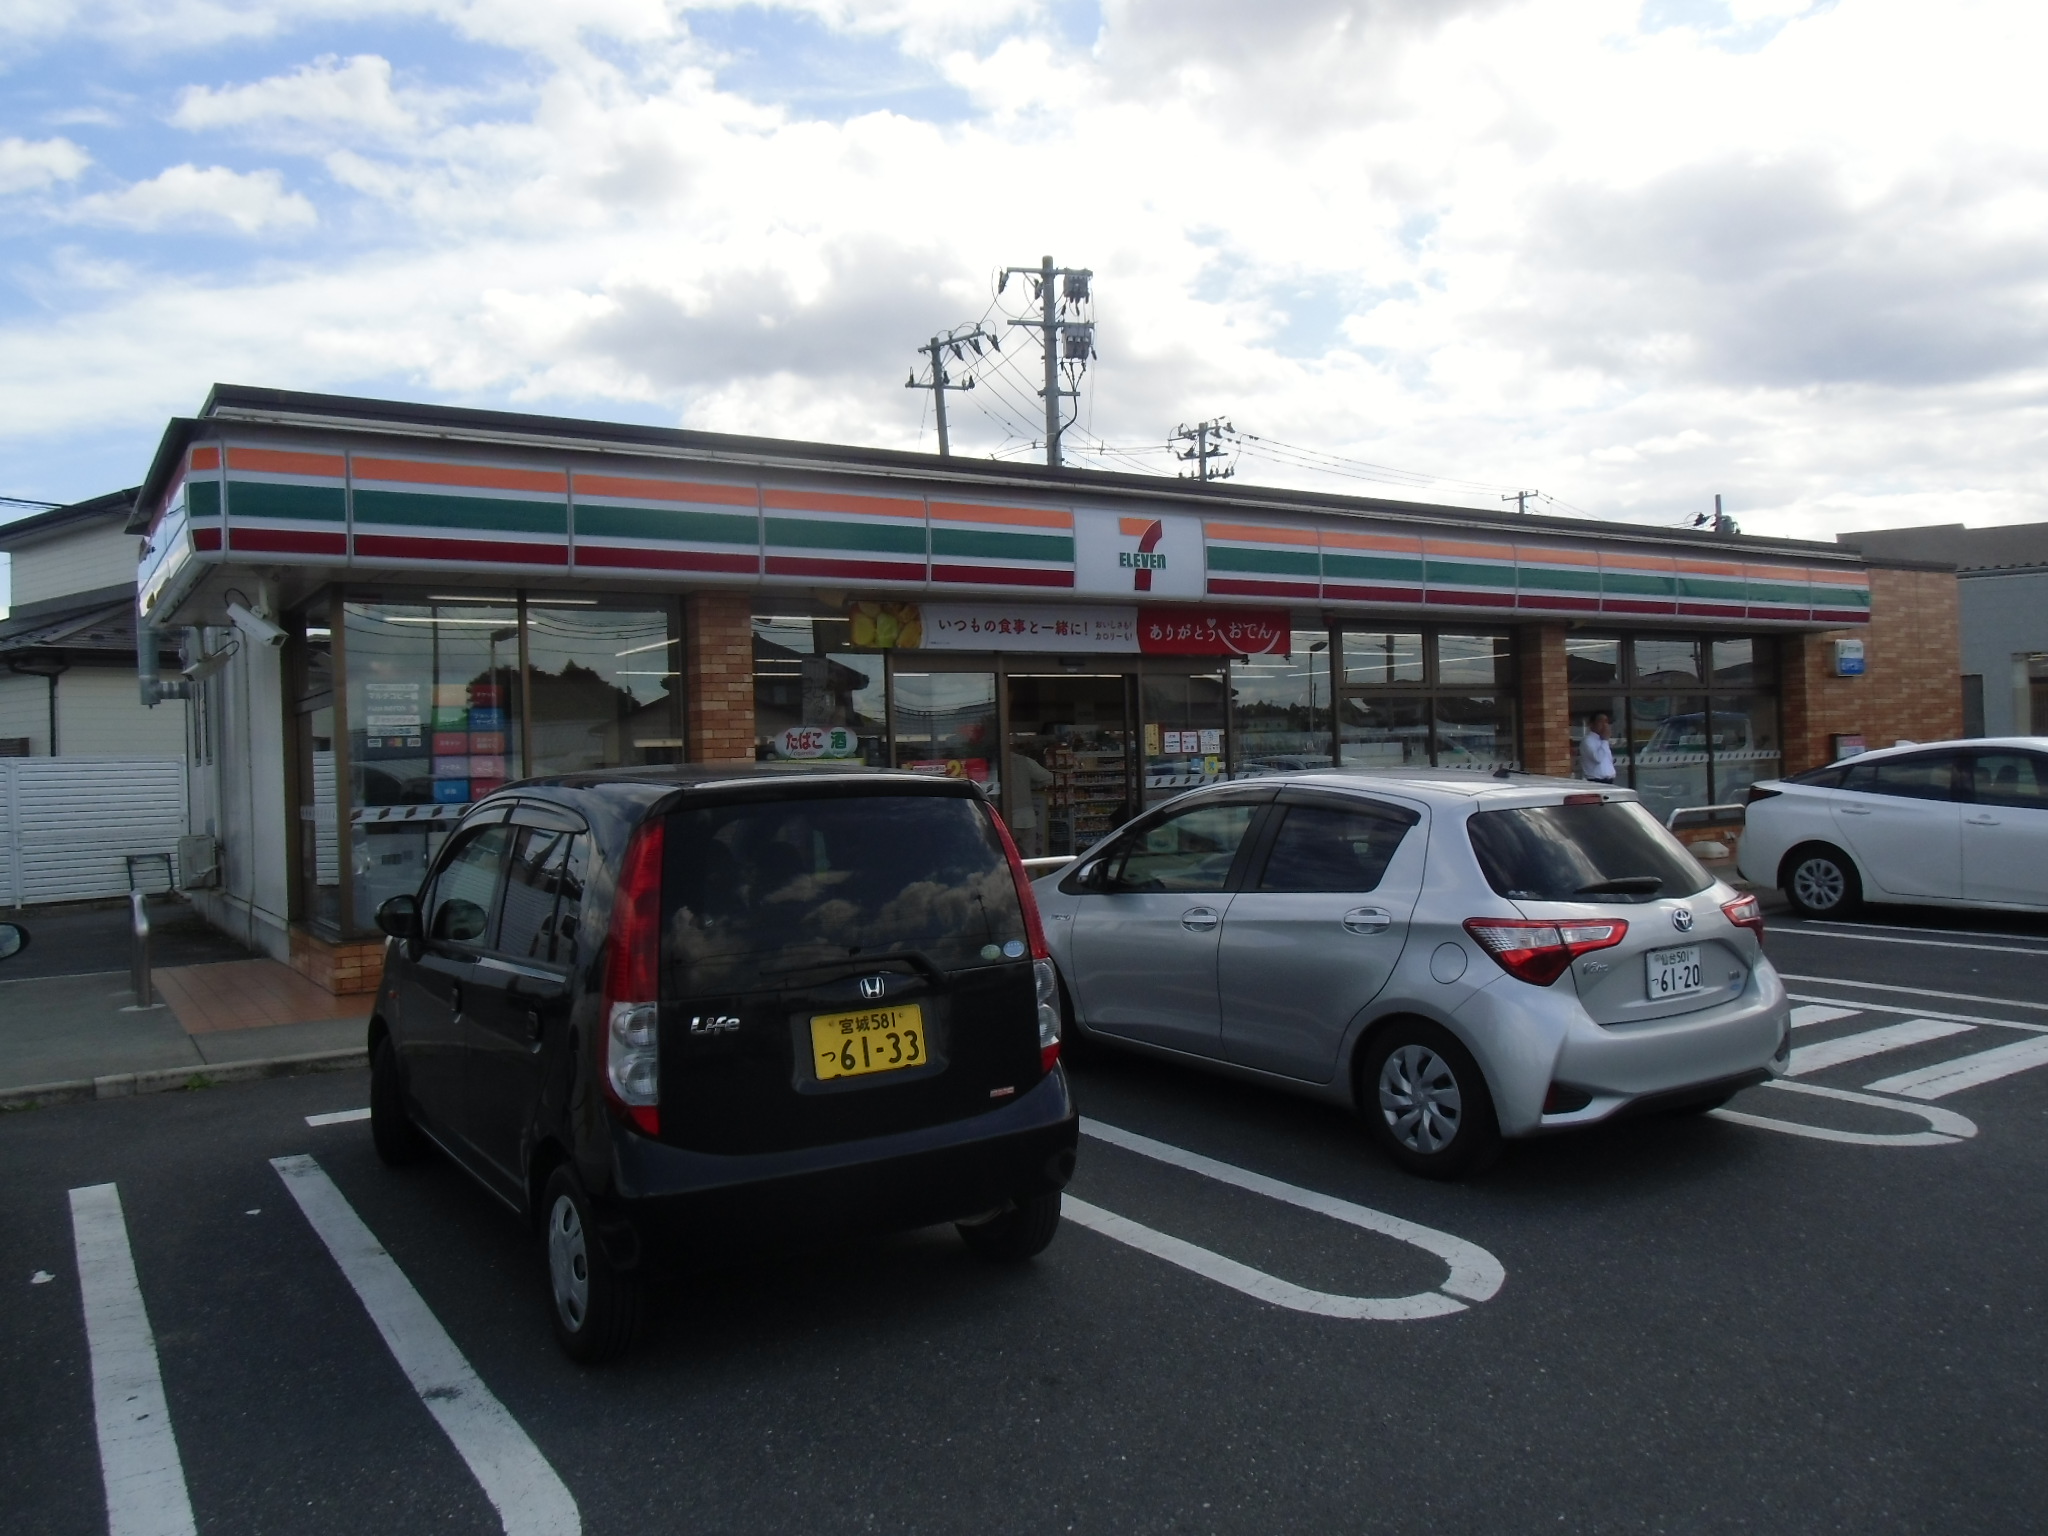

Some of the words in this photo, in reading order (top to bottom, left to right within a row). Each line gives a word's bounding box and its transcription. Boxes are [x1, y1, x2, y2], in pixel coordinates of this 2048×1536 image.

[1228, 621, 1273, 640] おでん
[785, 731, 824, 751] たばこ
[831, 731, 847, 749] 酒
[840, 1029, 920, 1071] 61-33
